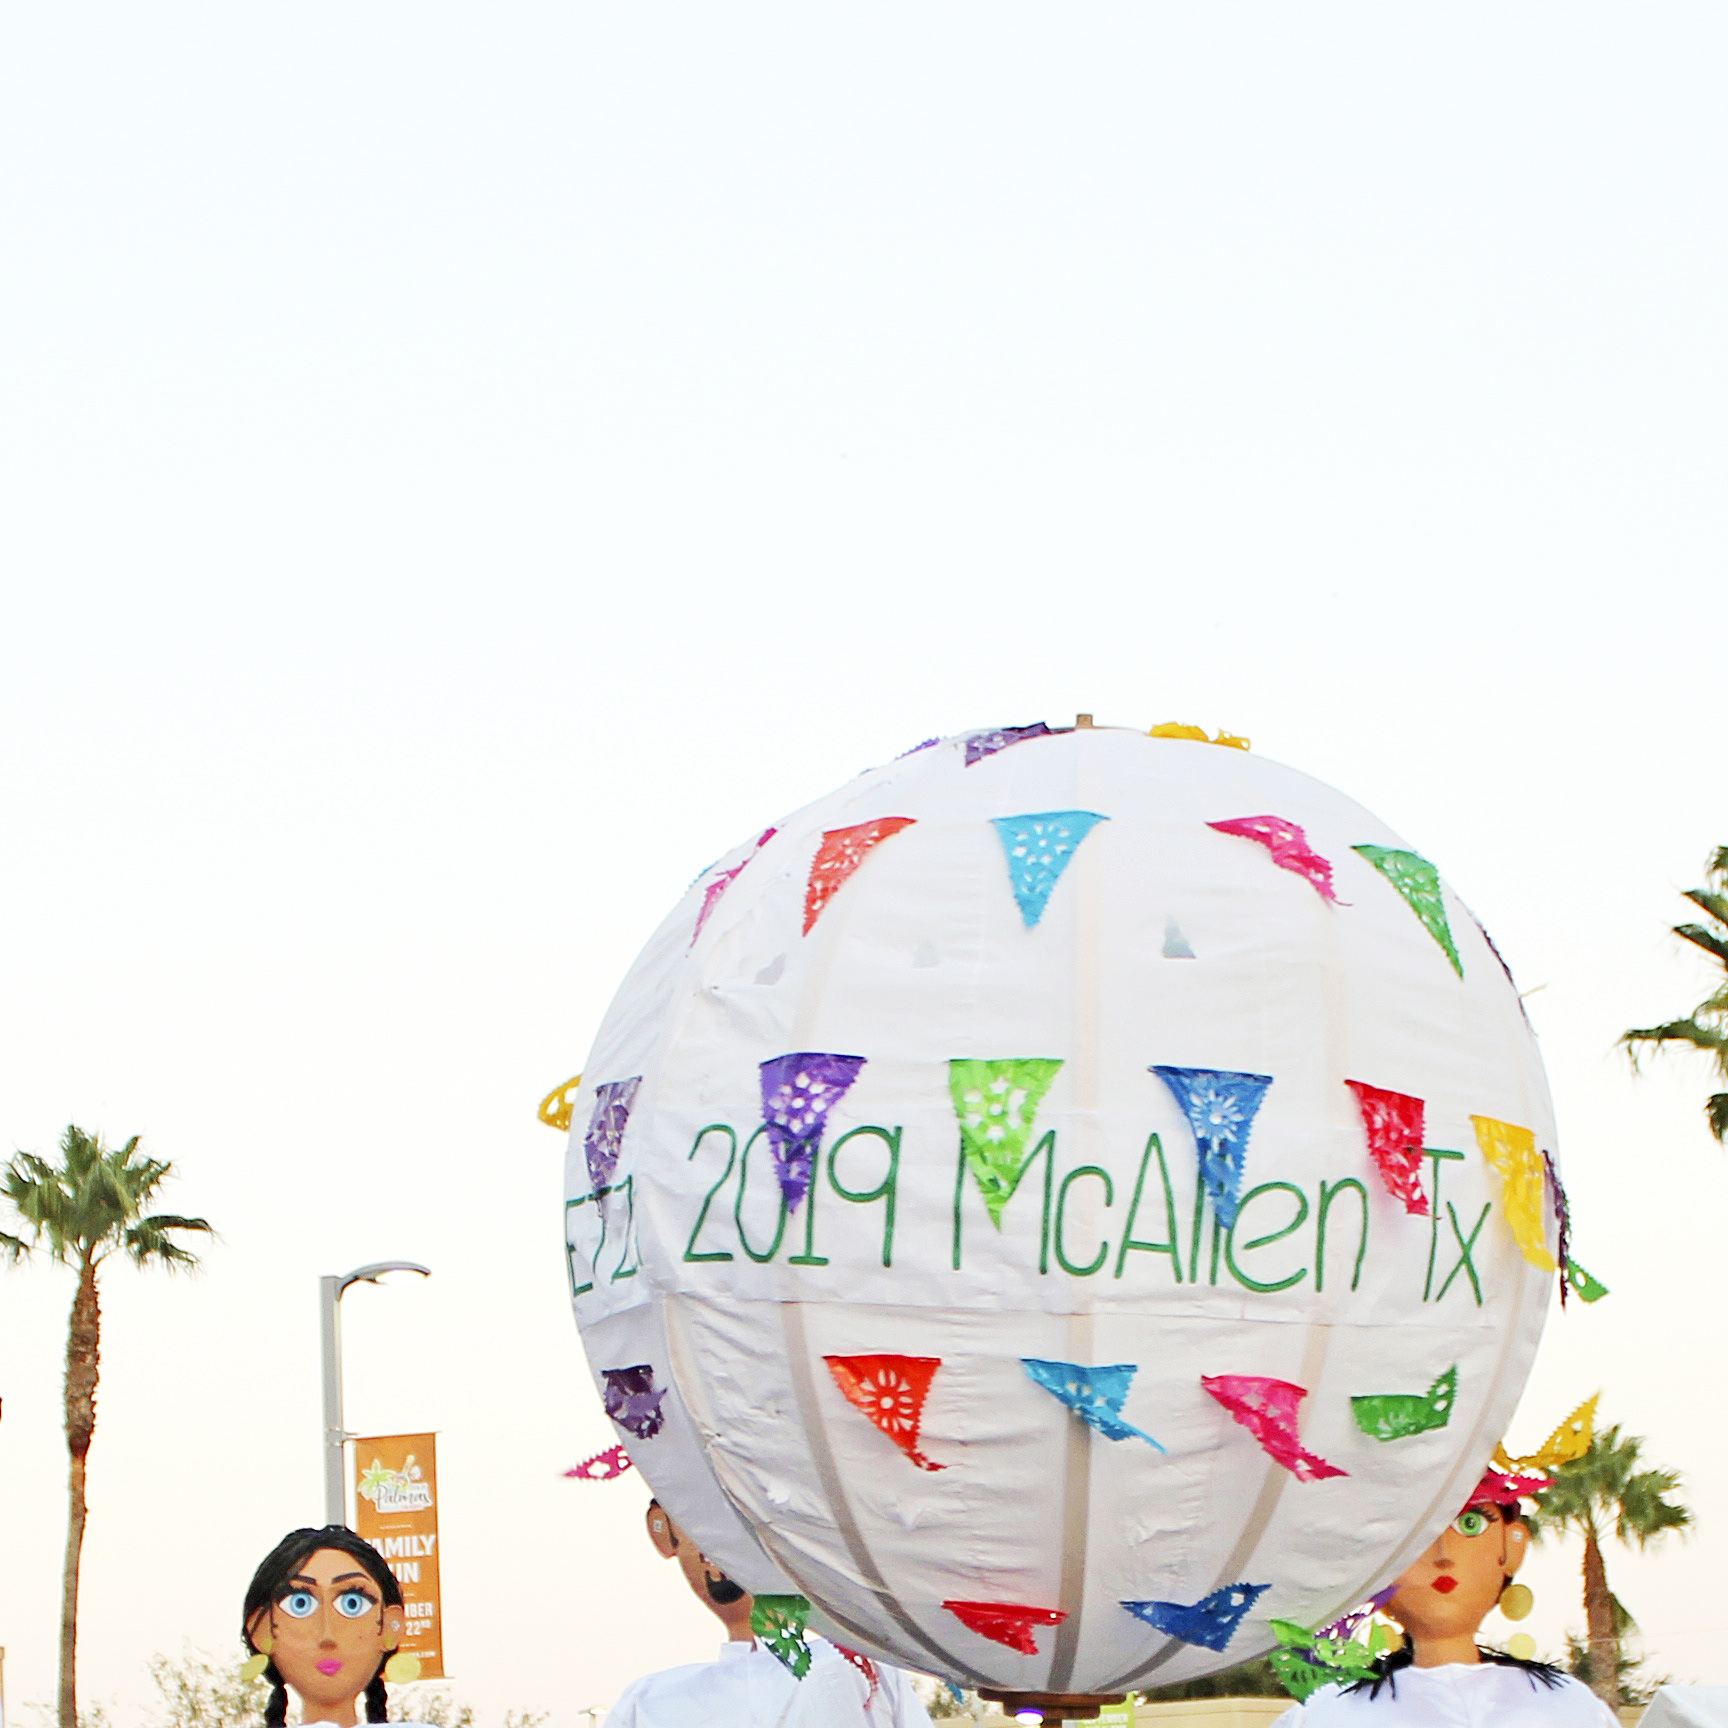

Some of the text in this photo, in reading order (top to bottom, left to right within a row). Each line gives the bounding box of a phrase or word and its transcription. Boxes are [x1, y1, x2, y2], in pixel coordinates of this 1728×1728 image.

[681, 1122, 904, 1269] 2019
[952, 1129, 1370, 1293] McAllen
[364, 1534, 436, 1559] AMILY
[387, 1561, 421, 1584] UN
